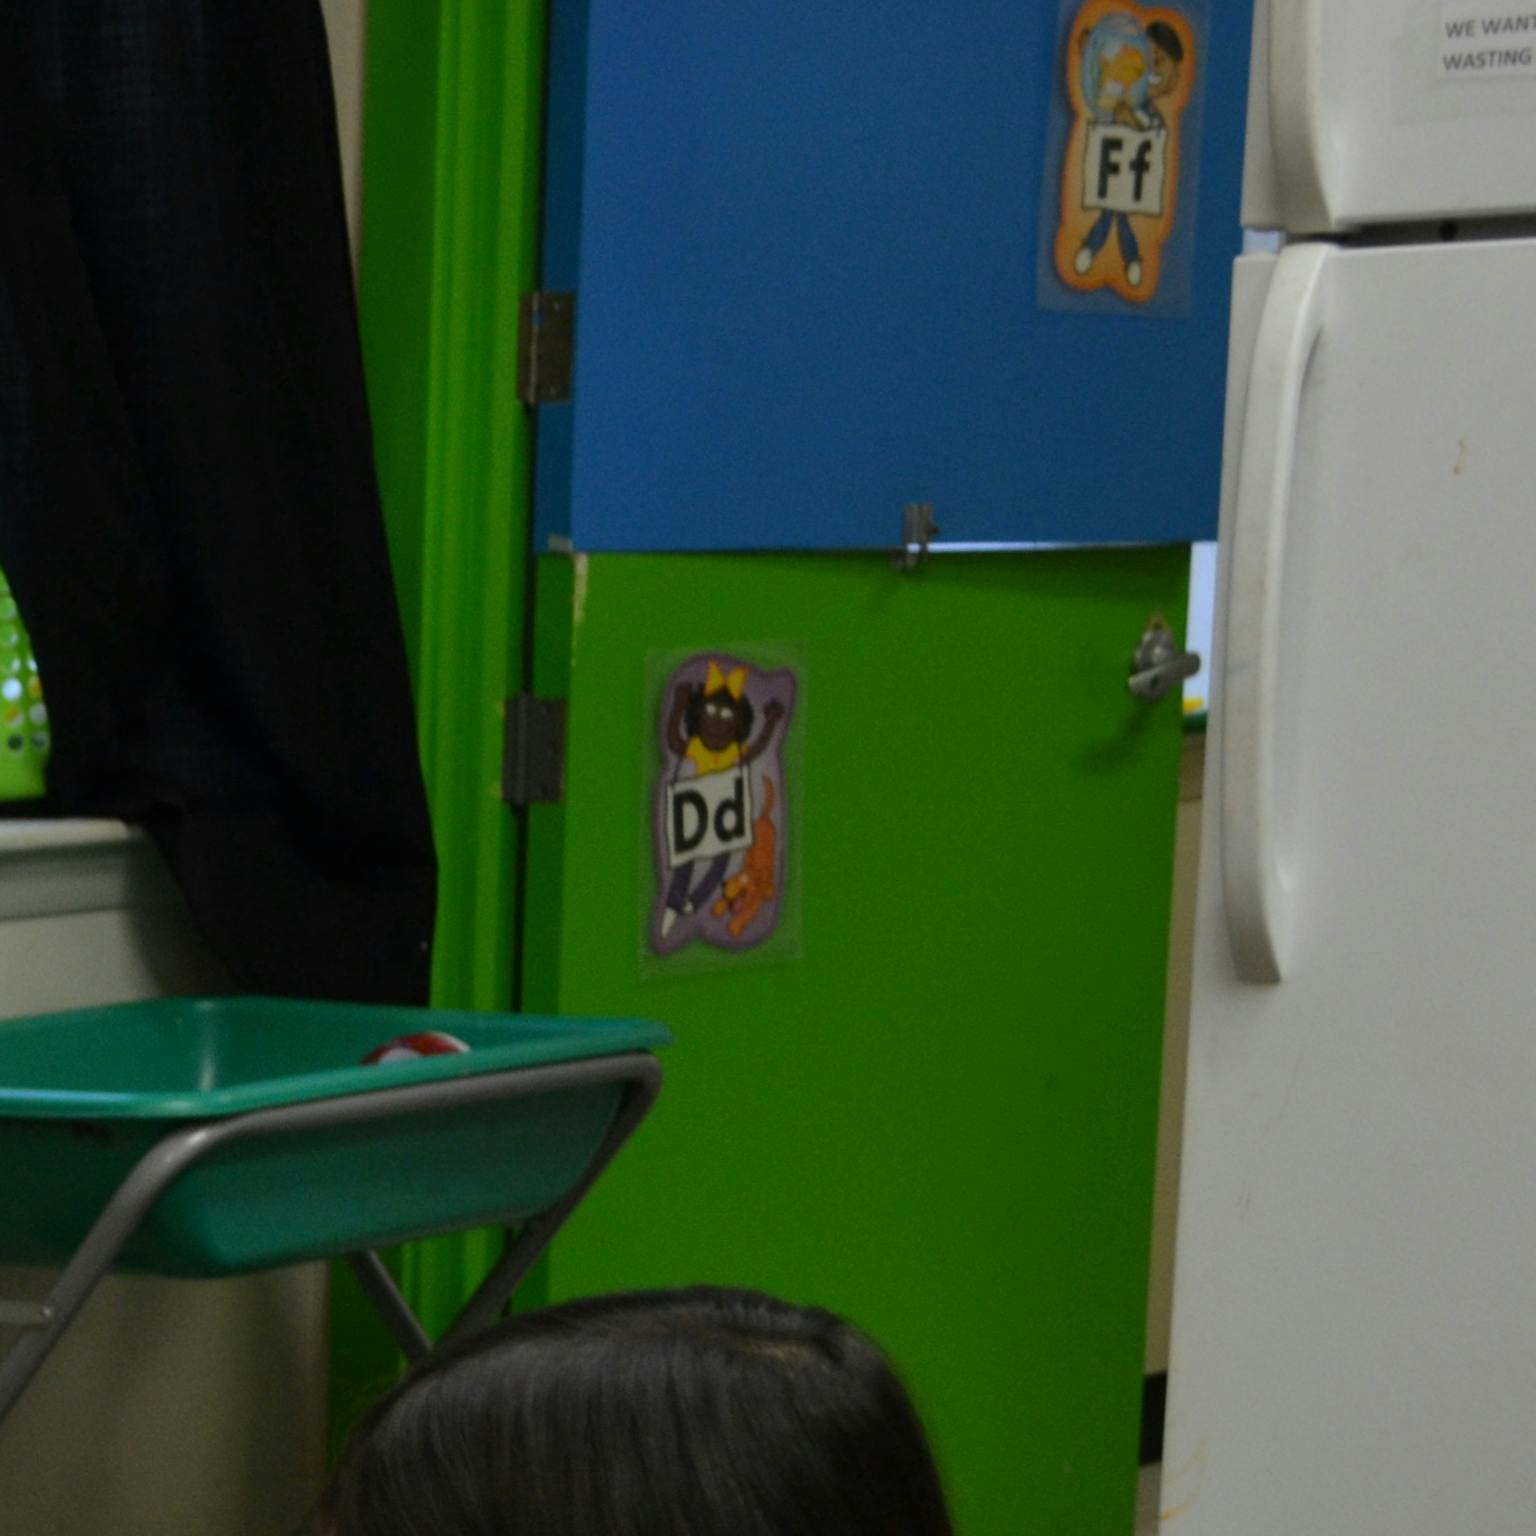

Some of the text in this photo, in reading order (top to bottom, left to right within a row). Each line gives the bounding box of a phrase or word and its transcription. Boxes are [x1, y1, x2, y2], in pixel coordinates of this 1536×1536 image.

[1444, 19, 1475, 38] WE
[1442, 47, 1533, 71] WASTING
[1096, 137, 1152, 202] Ff
[673, 776, 746, 853] Dd
